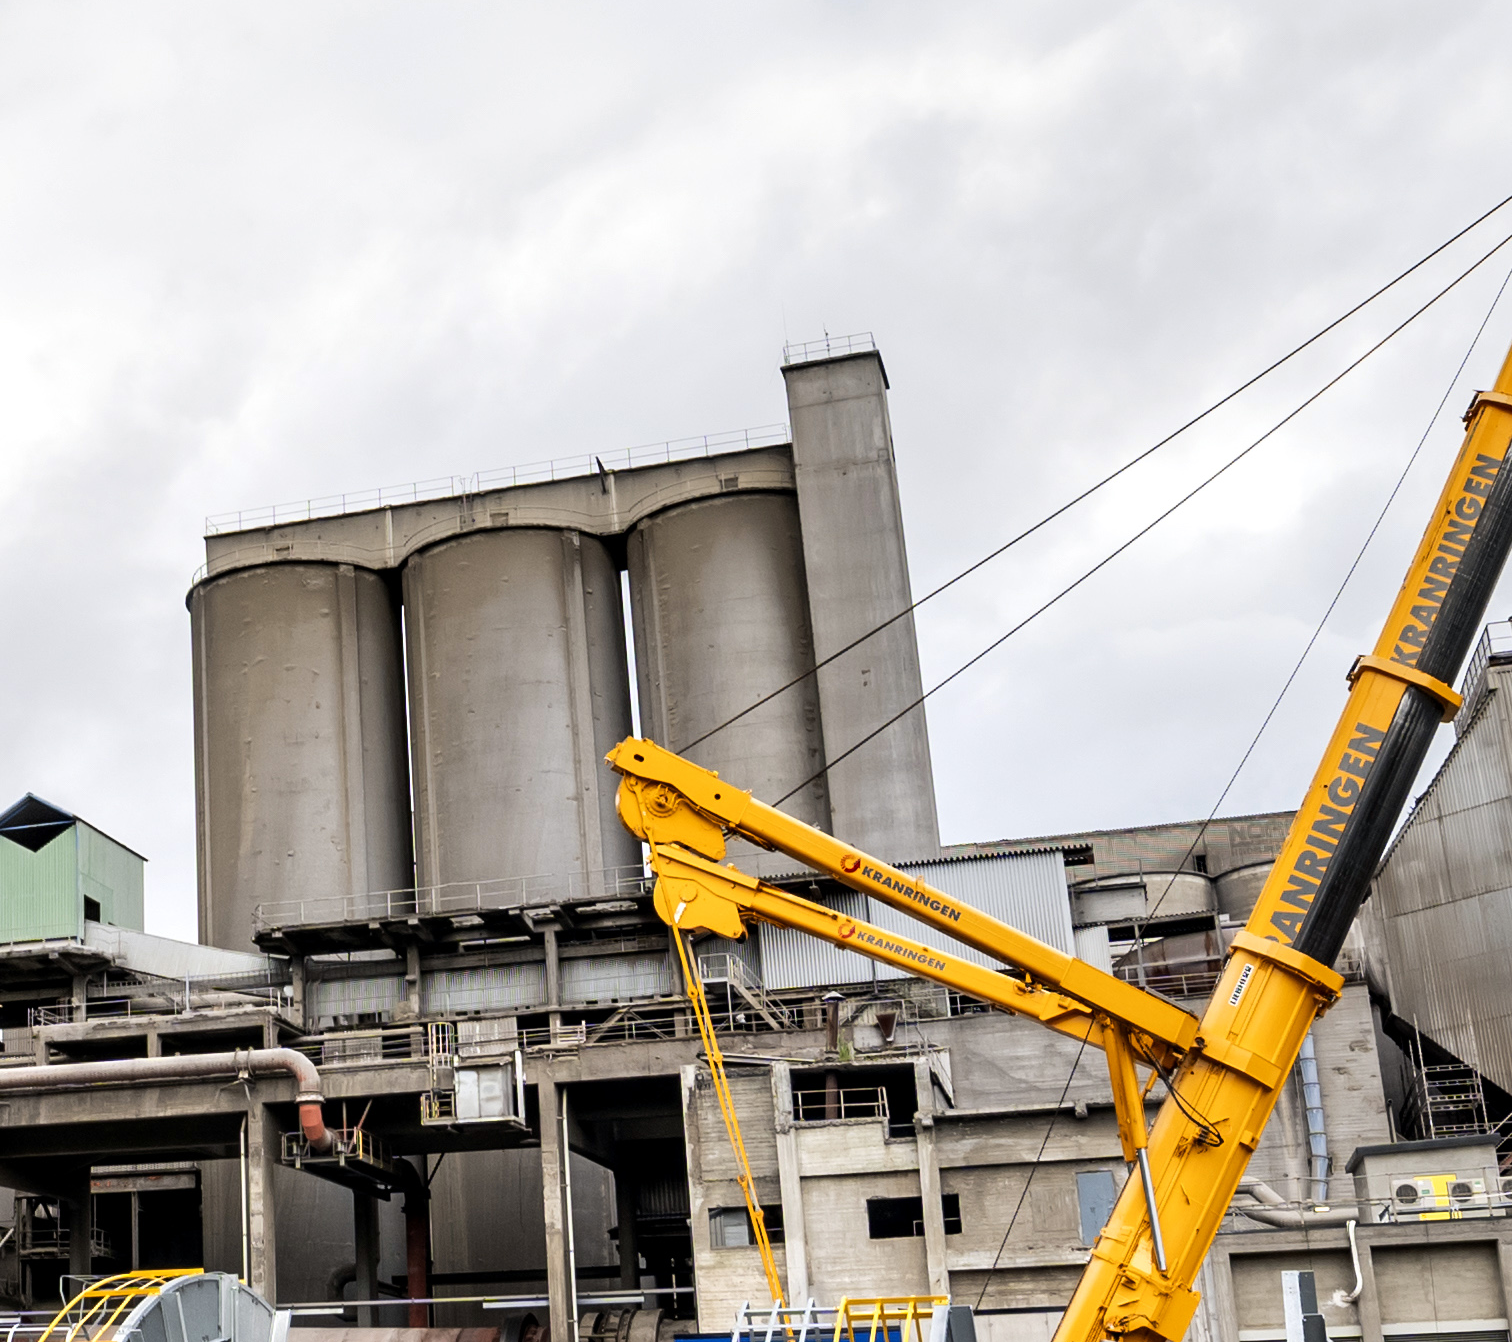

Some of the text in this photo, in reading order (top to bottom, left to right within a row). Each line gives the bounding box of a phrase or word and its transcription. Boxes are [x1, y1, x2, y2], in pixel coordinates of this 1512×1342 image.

[1391, 453, 1503, 668] KRANRINGEN
[861, 865, 962, 922] KRANRINGEN
[1264, 723, 1386, 947] ANRINGEN
[856, 930, 946, 971] KRANRINGEN
